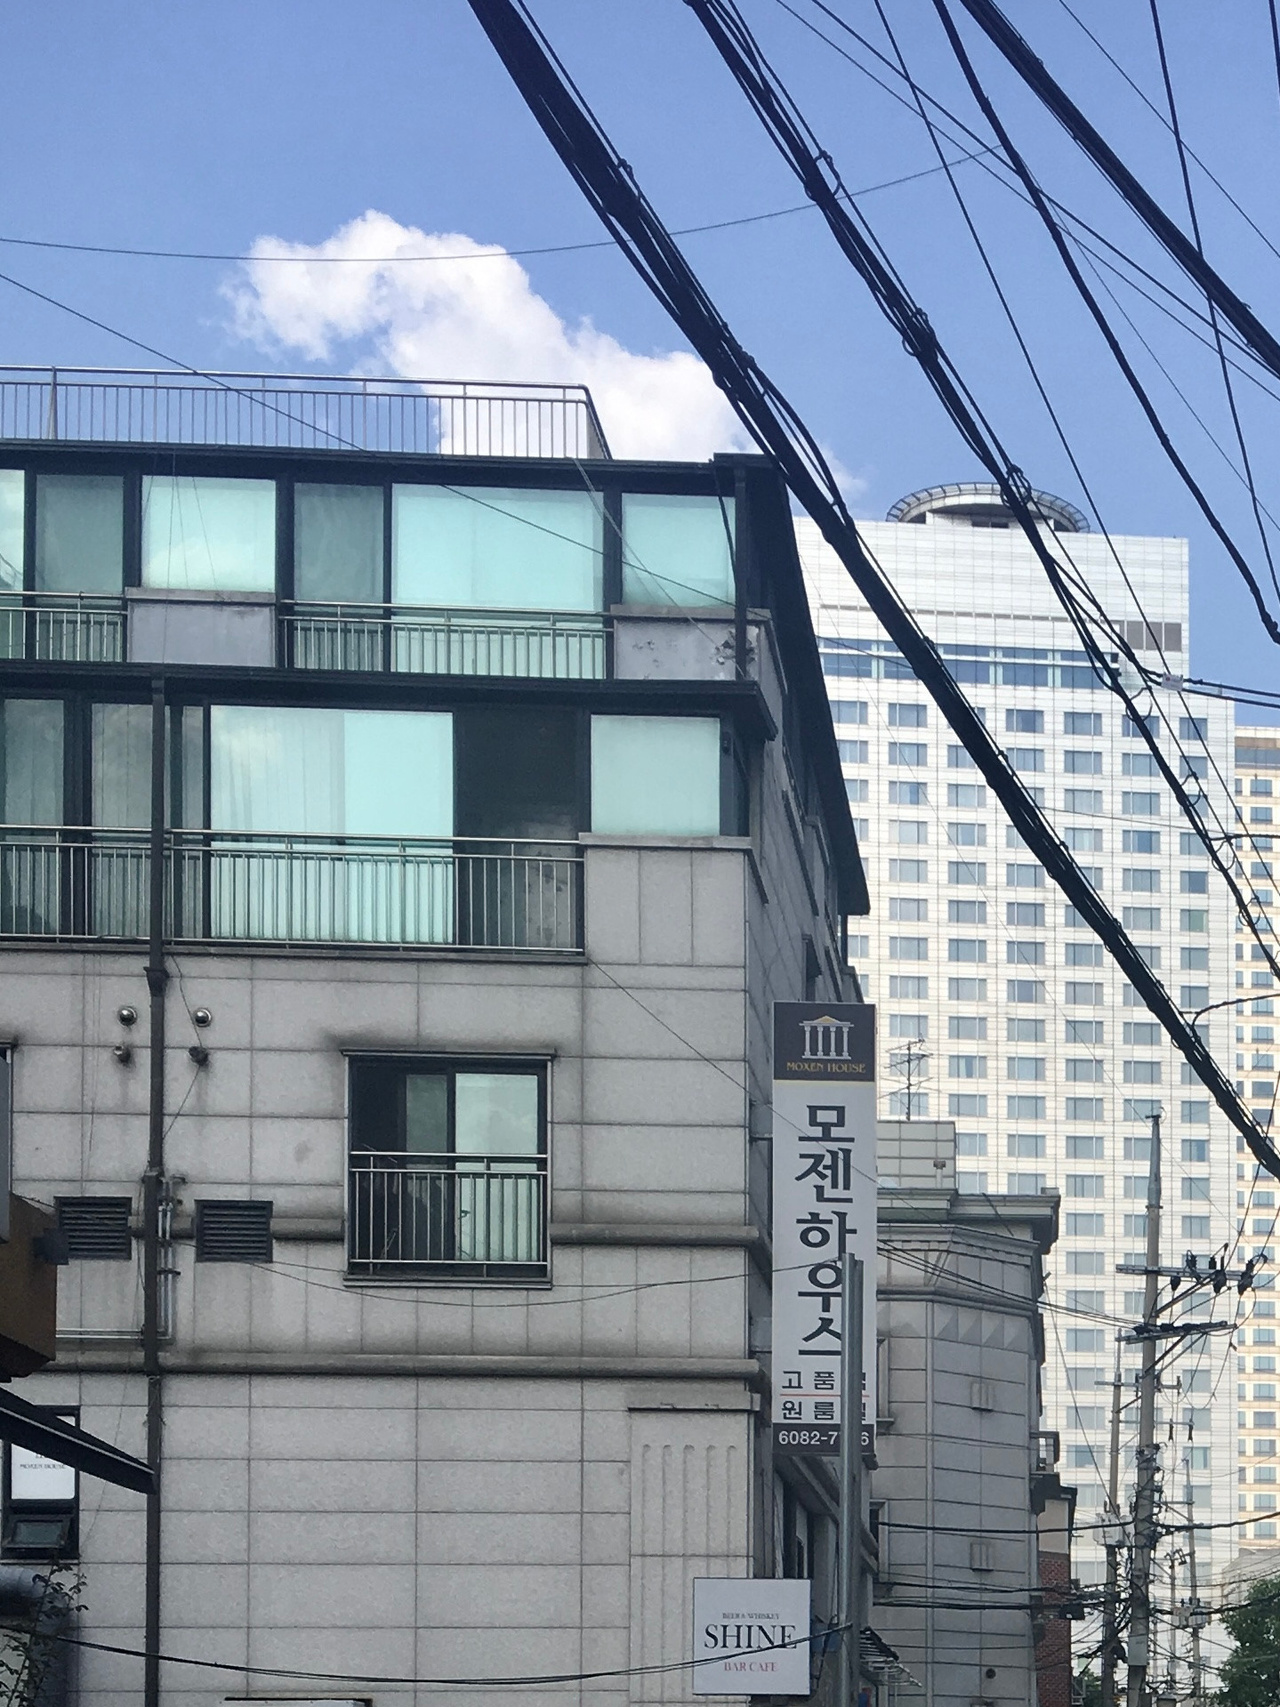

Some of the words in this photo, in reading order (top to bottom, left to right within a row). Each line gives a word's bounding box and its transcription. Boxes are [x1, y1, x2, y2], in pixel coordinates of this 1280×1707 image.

[786, 1061, 823, 1072] MOXEN
[827, 1062, 867, 1074] HOUSE
[795, 1104, 858, 1357] 모젠하우스
[782, 1370, 866, 1391] 고품
[782, 1400, 866, 1421] 원룸
[778, 1430, 870, 1446] 6082-76
[704, 1623, 797, 1650] SHINE
[724, 1661, 747, 1672] BAR
[749, 1661, 778, 1672] CAFE
